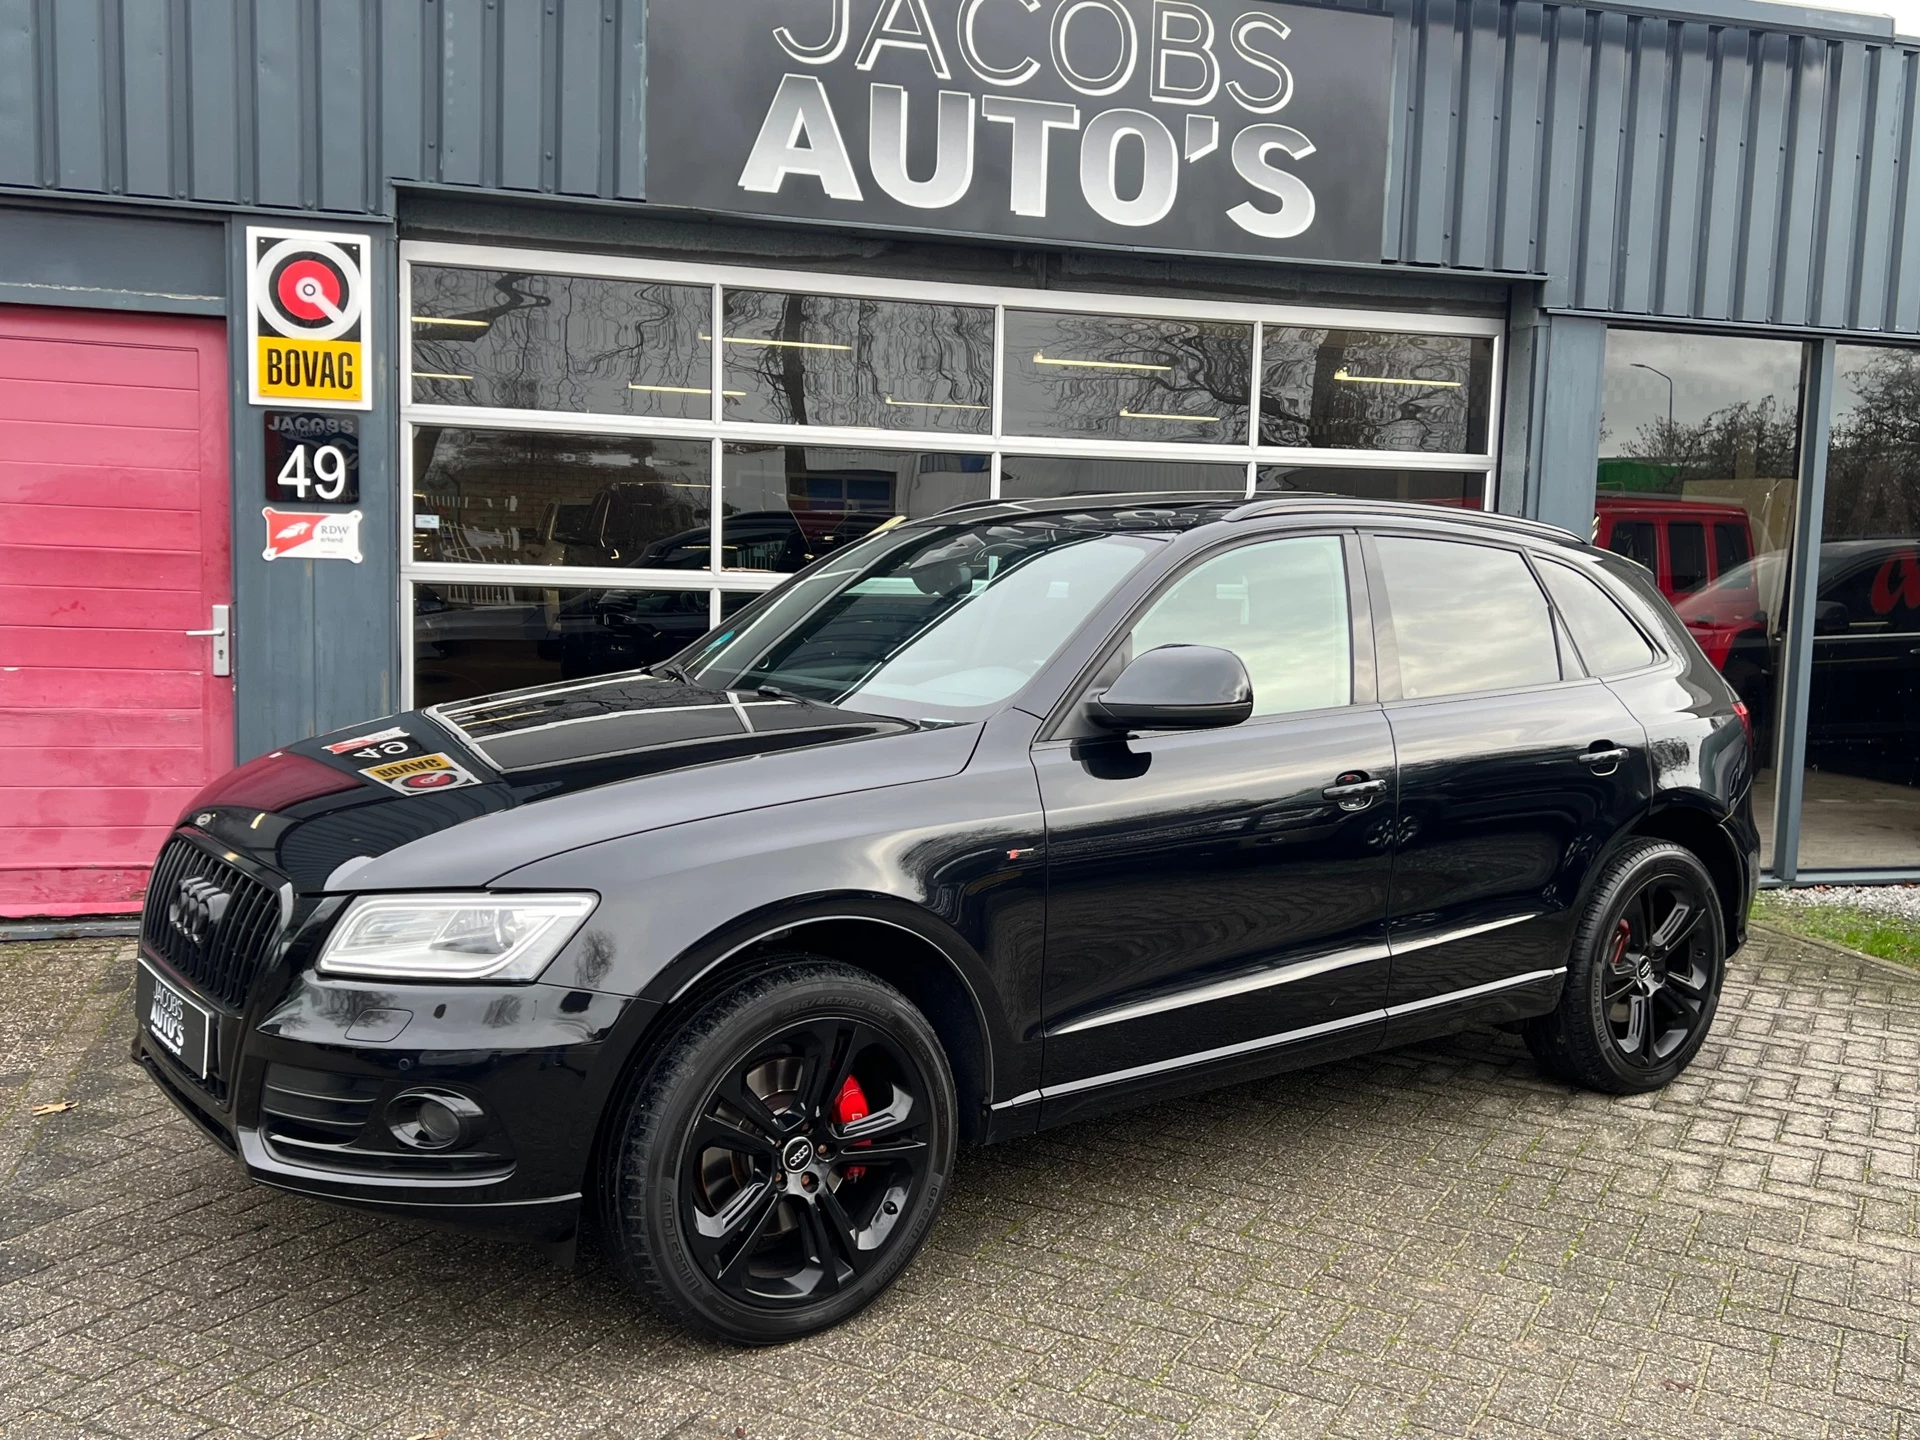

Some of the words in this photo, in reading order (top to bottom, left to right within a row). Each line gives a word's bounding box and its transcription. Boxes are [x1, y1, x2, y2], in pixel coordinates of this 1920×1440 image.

[772, 0, 1294, 115] JACOBS
[738, 73, 1317, 239] AUTO'S
[266, 347, 354, 390] BOVAG
[267, 415, 355, 434] JACOBS
[277, 444, 346, 500] 49
[320, 525, 349, 535] RDW
[150, 999, 185, 1047] AUTO'S
